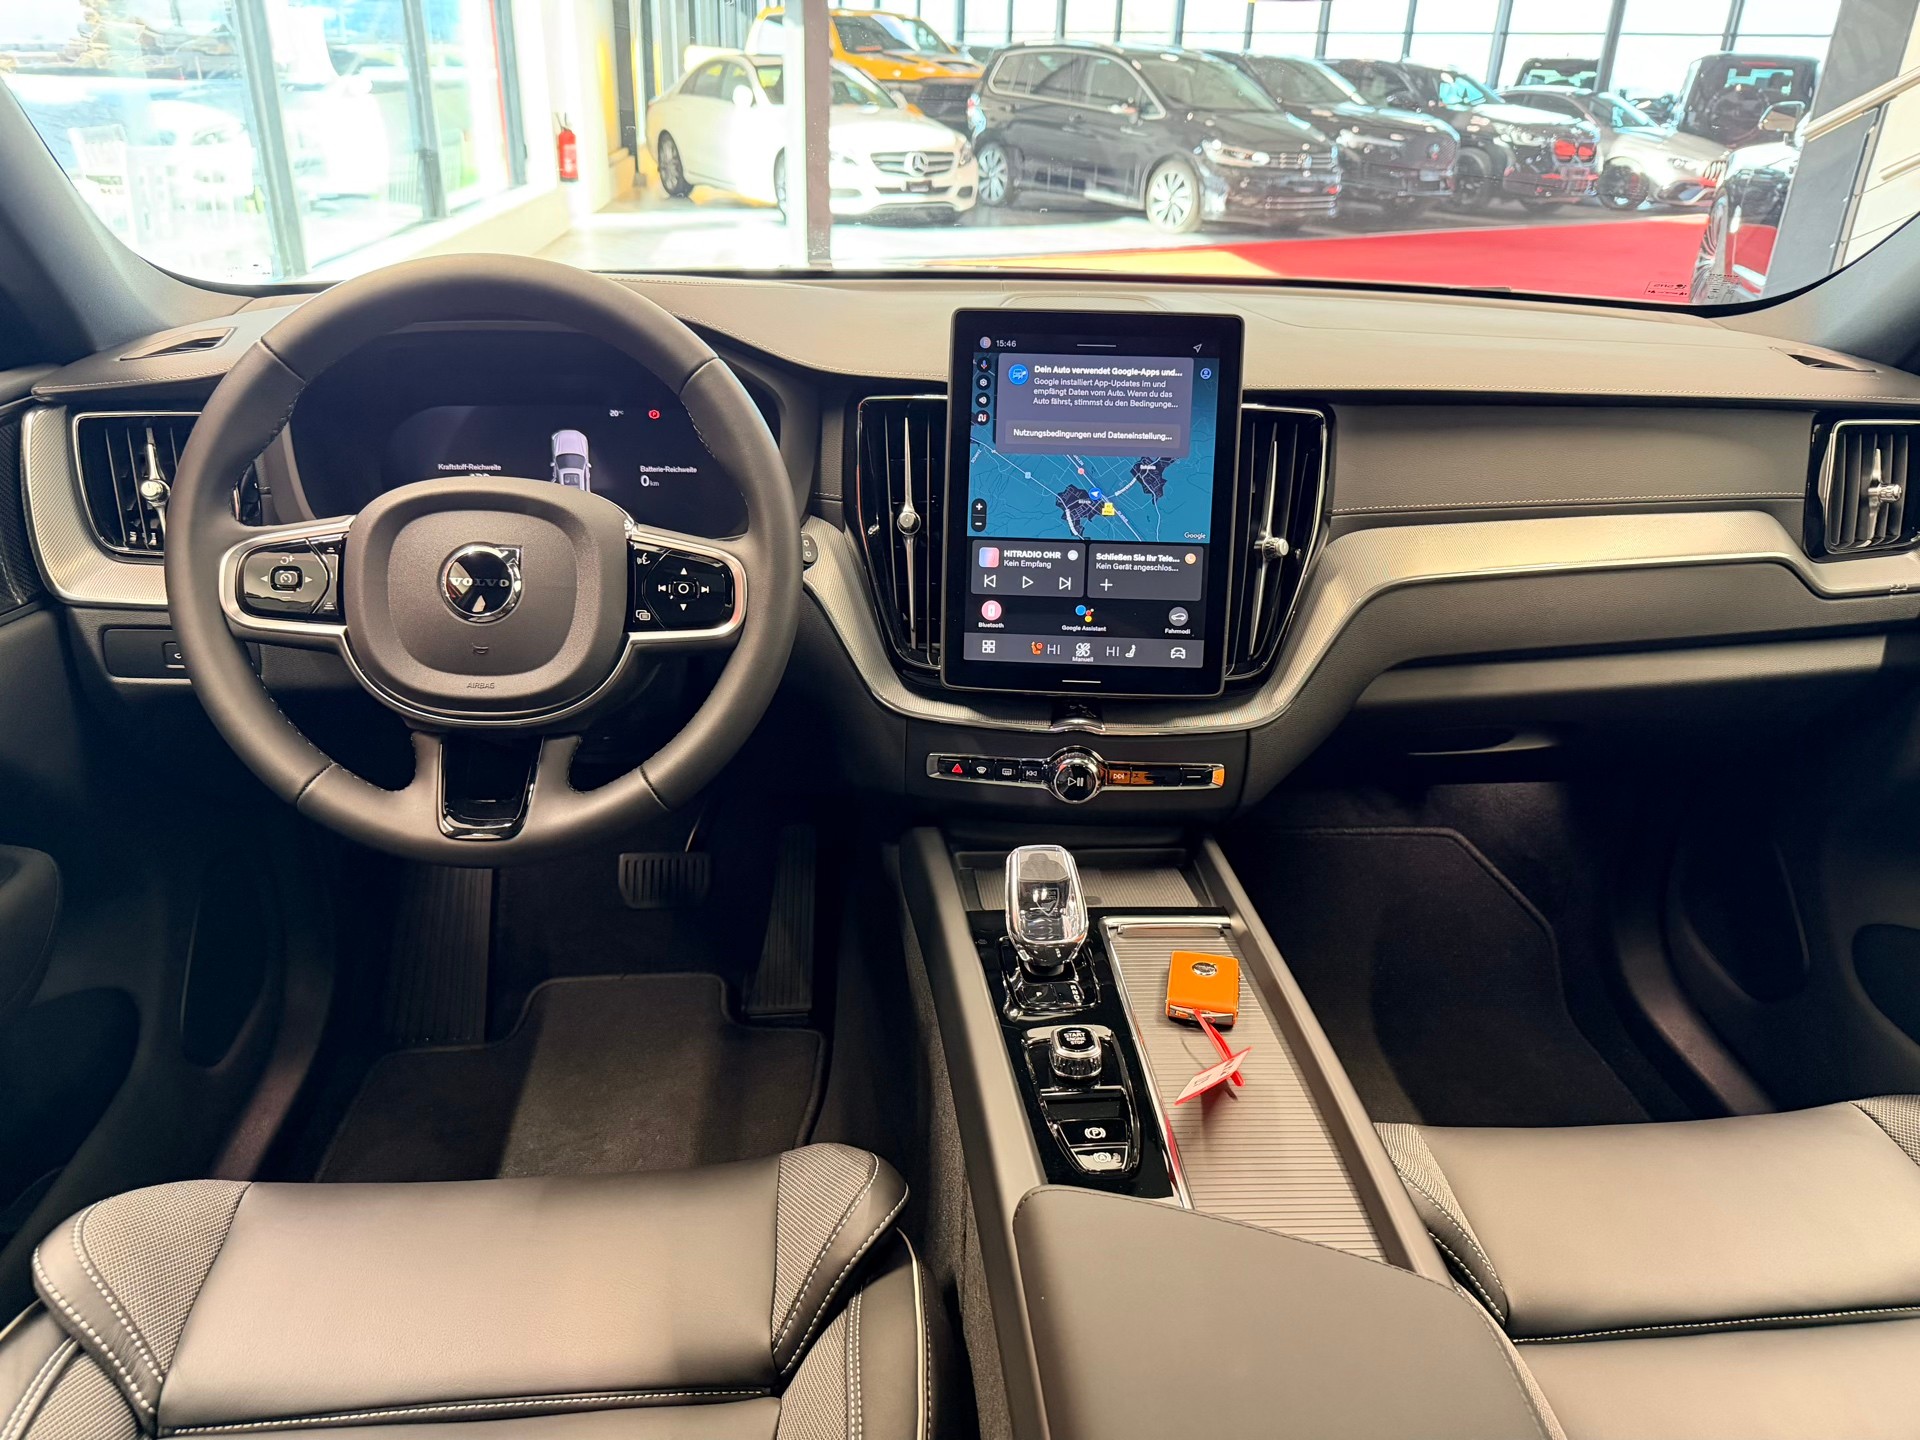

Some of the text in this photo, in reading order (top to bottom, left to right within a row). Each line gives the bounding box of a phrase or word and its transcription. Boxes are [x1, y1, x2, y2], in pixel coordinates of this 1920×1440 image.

[996, 340, 1016, 348] 15:46
[1034, 365, 1051, 373] Dein
[1052, 366, 1070, 374] Auto
[1072, 366, 1110, 375] verwendet
[1112, 368, 1160, 378] Google-Apps
[1034, 377, 1060, 386] Google
[1060, 378, 1092, 386] installiert
[1094, 379, 1140, 388] App-Updates
[1034, 388, 1067, 396] empfängt
[1068, 388, 1089, 396] Daten
[1050, 398, 1073, 406] fährst,
[1013, 428, 1092, 439] Nutzungsbedingungen
[640, 465, 698, 473] Batterie-Reichweite
[640, 474, 650, 486] 0
[1004, 550, 1062, 560] HITRADIO OHR
[1096, 552, 1132, 562] Schließen
[1020, 560, 1052, 569] Empfang
[1113, 562, 1132, 570] Gerät
[449, 577, 510, 588] VOLVO
[1046, 644, 1060, 655] HI
[1106, 646, 1120, 657] HI
